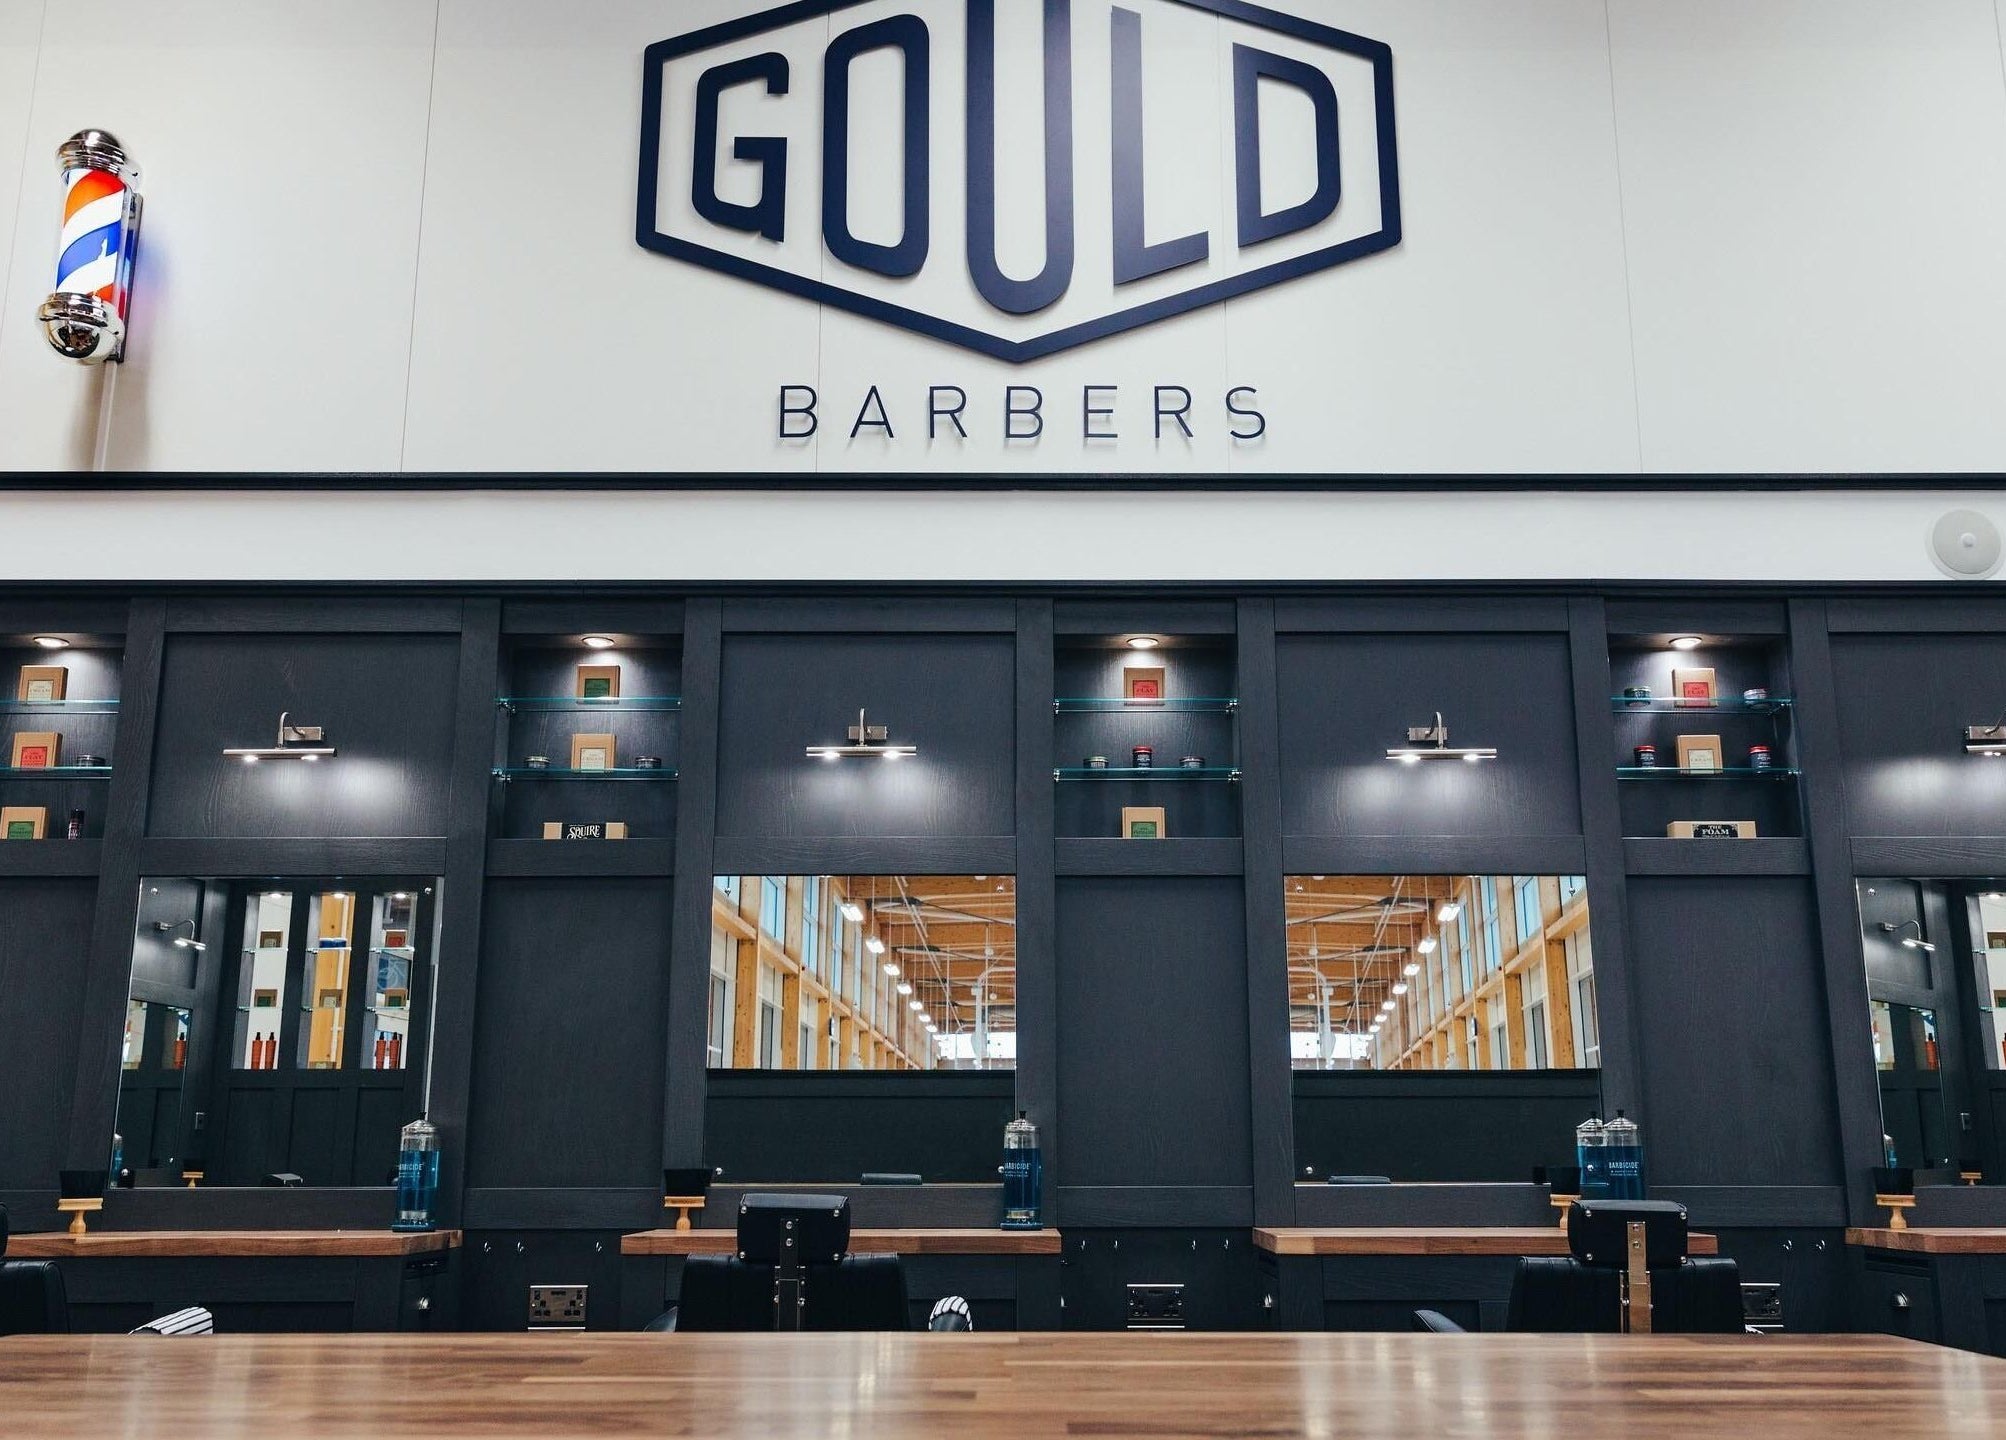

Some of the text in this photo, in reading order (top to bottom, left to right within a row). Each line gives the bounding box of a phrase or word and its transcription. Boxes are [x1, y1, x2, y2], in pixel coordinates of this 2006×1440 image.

[692, 0, 1341, 315] GOULD
[778, 384, 1267, 439] BARBERS
[567, 825, 601, 839] SQUIRE
[1608, 1161, 1638, 1169] BARBICIDE
